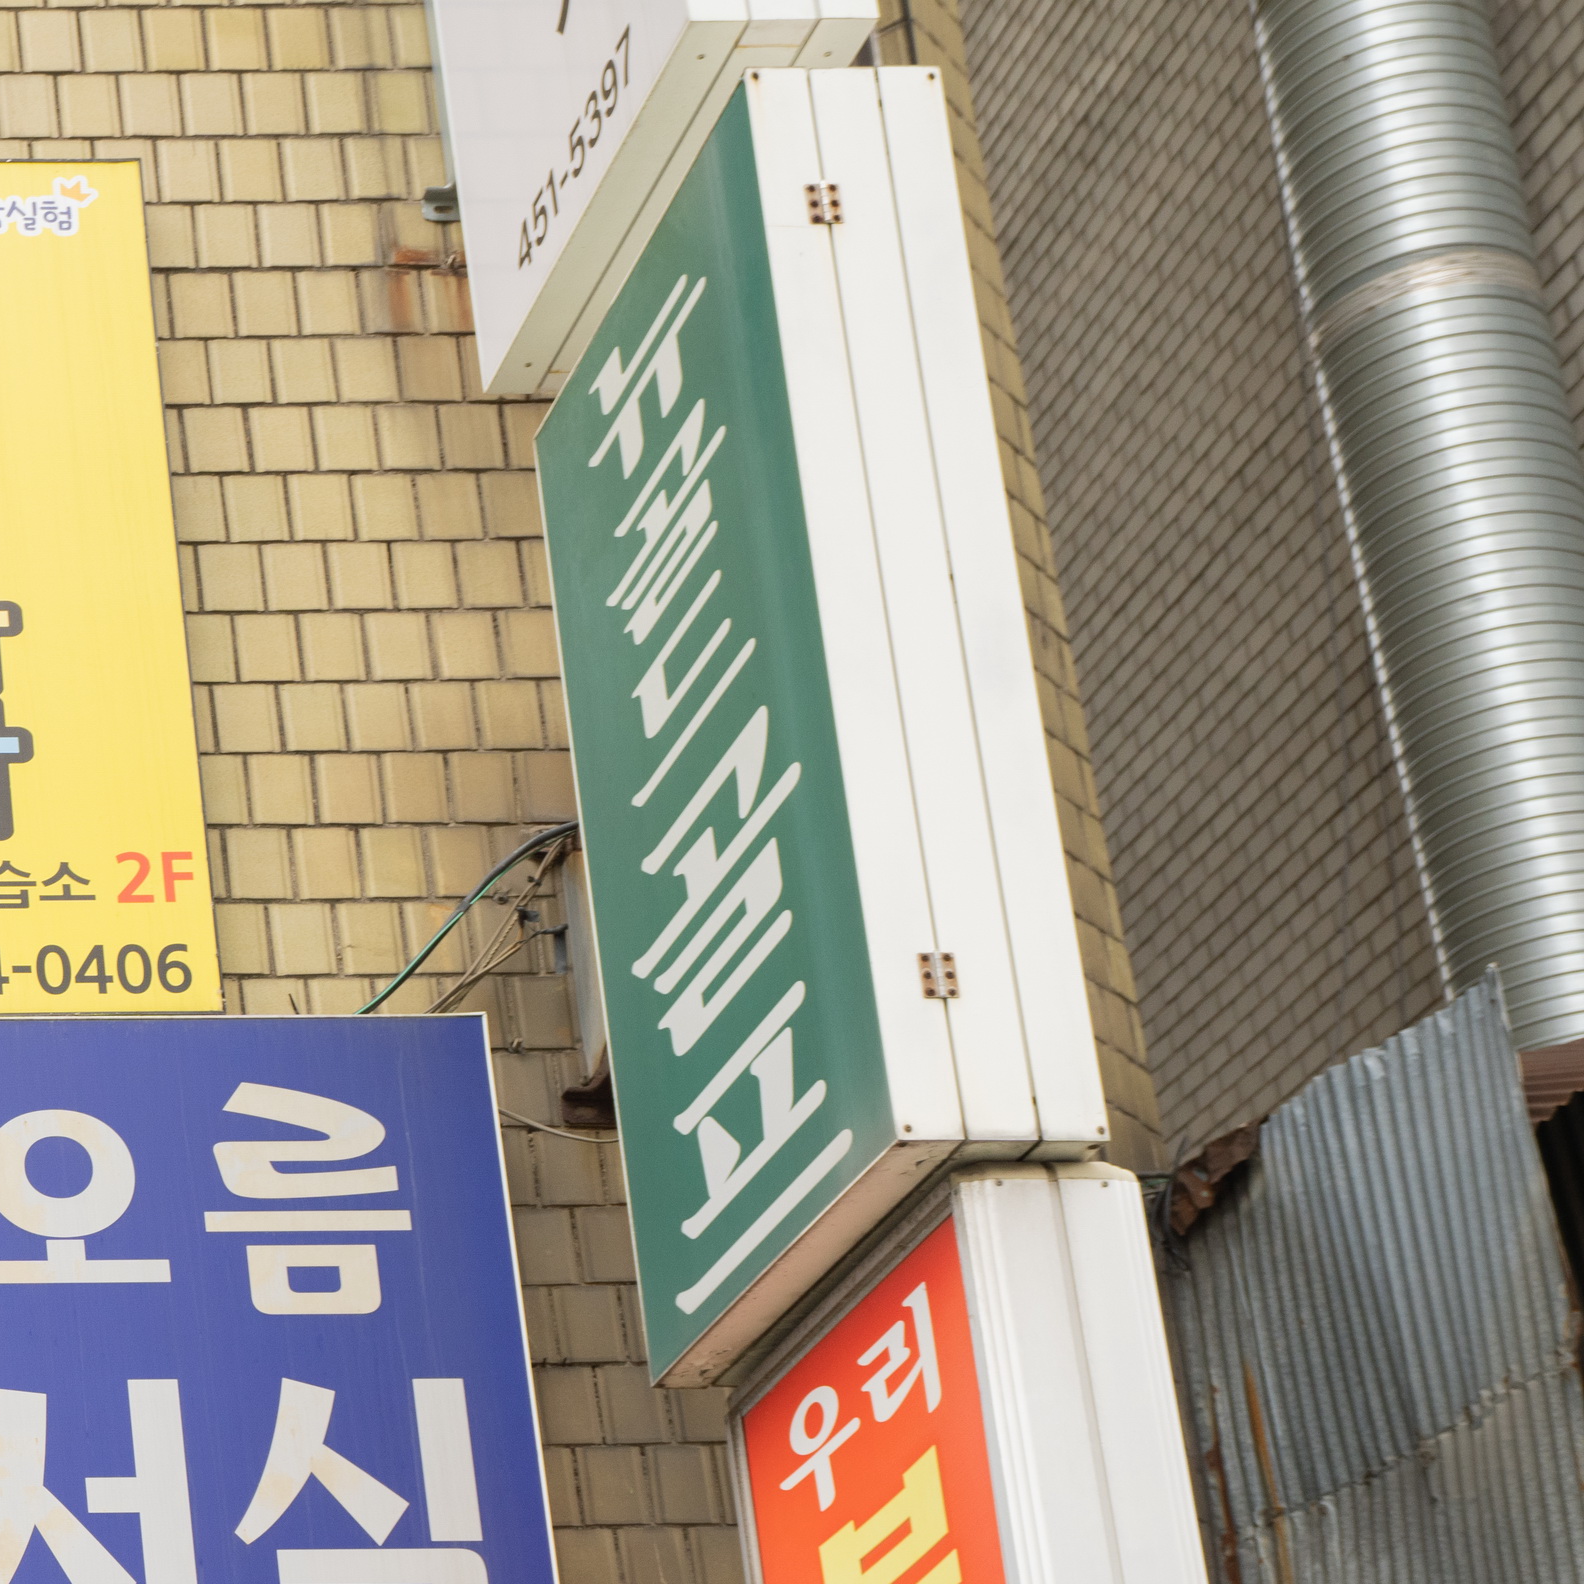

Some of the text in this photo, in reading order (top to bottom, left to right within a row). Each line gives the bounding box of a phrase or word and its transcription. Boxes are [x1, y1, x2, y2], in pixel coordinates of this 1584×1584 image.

[518, 26, 631, 270] 451-5397
[116, 851, 194, 903] 2F
[779, 1282, 943, 1512] 우리
